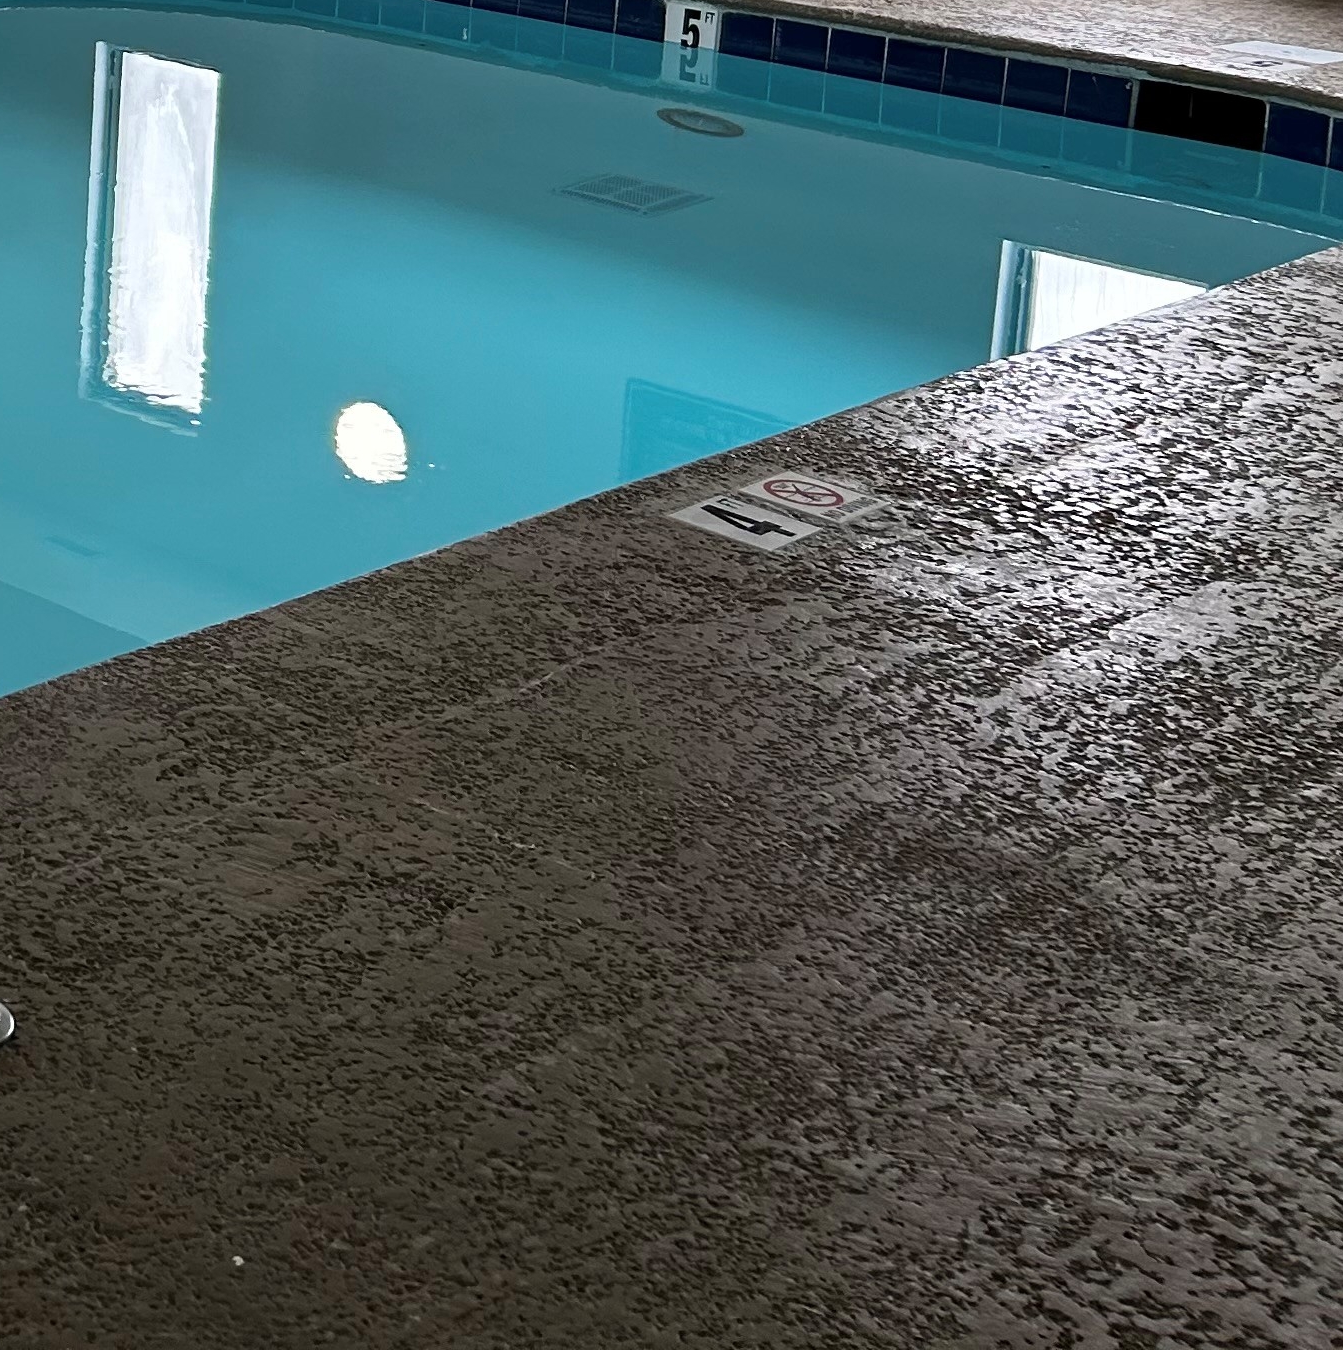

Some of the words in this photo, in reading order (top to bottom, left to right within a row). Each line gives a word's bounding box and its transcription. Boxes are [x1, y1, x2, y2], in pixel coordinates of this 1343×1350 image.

[680, 8, 702, 49] 5
[704, 12, 715, 24] FT
[701, 504, 797, 537] 4
